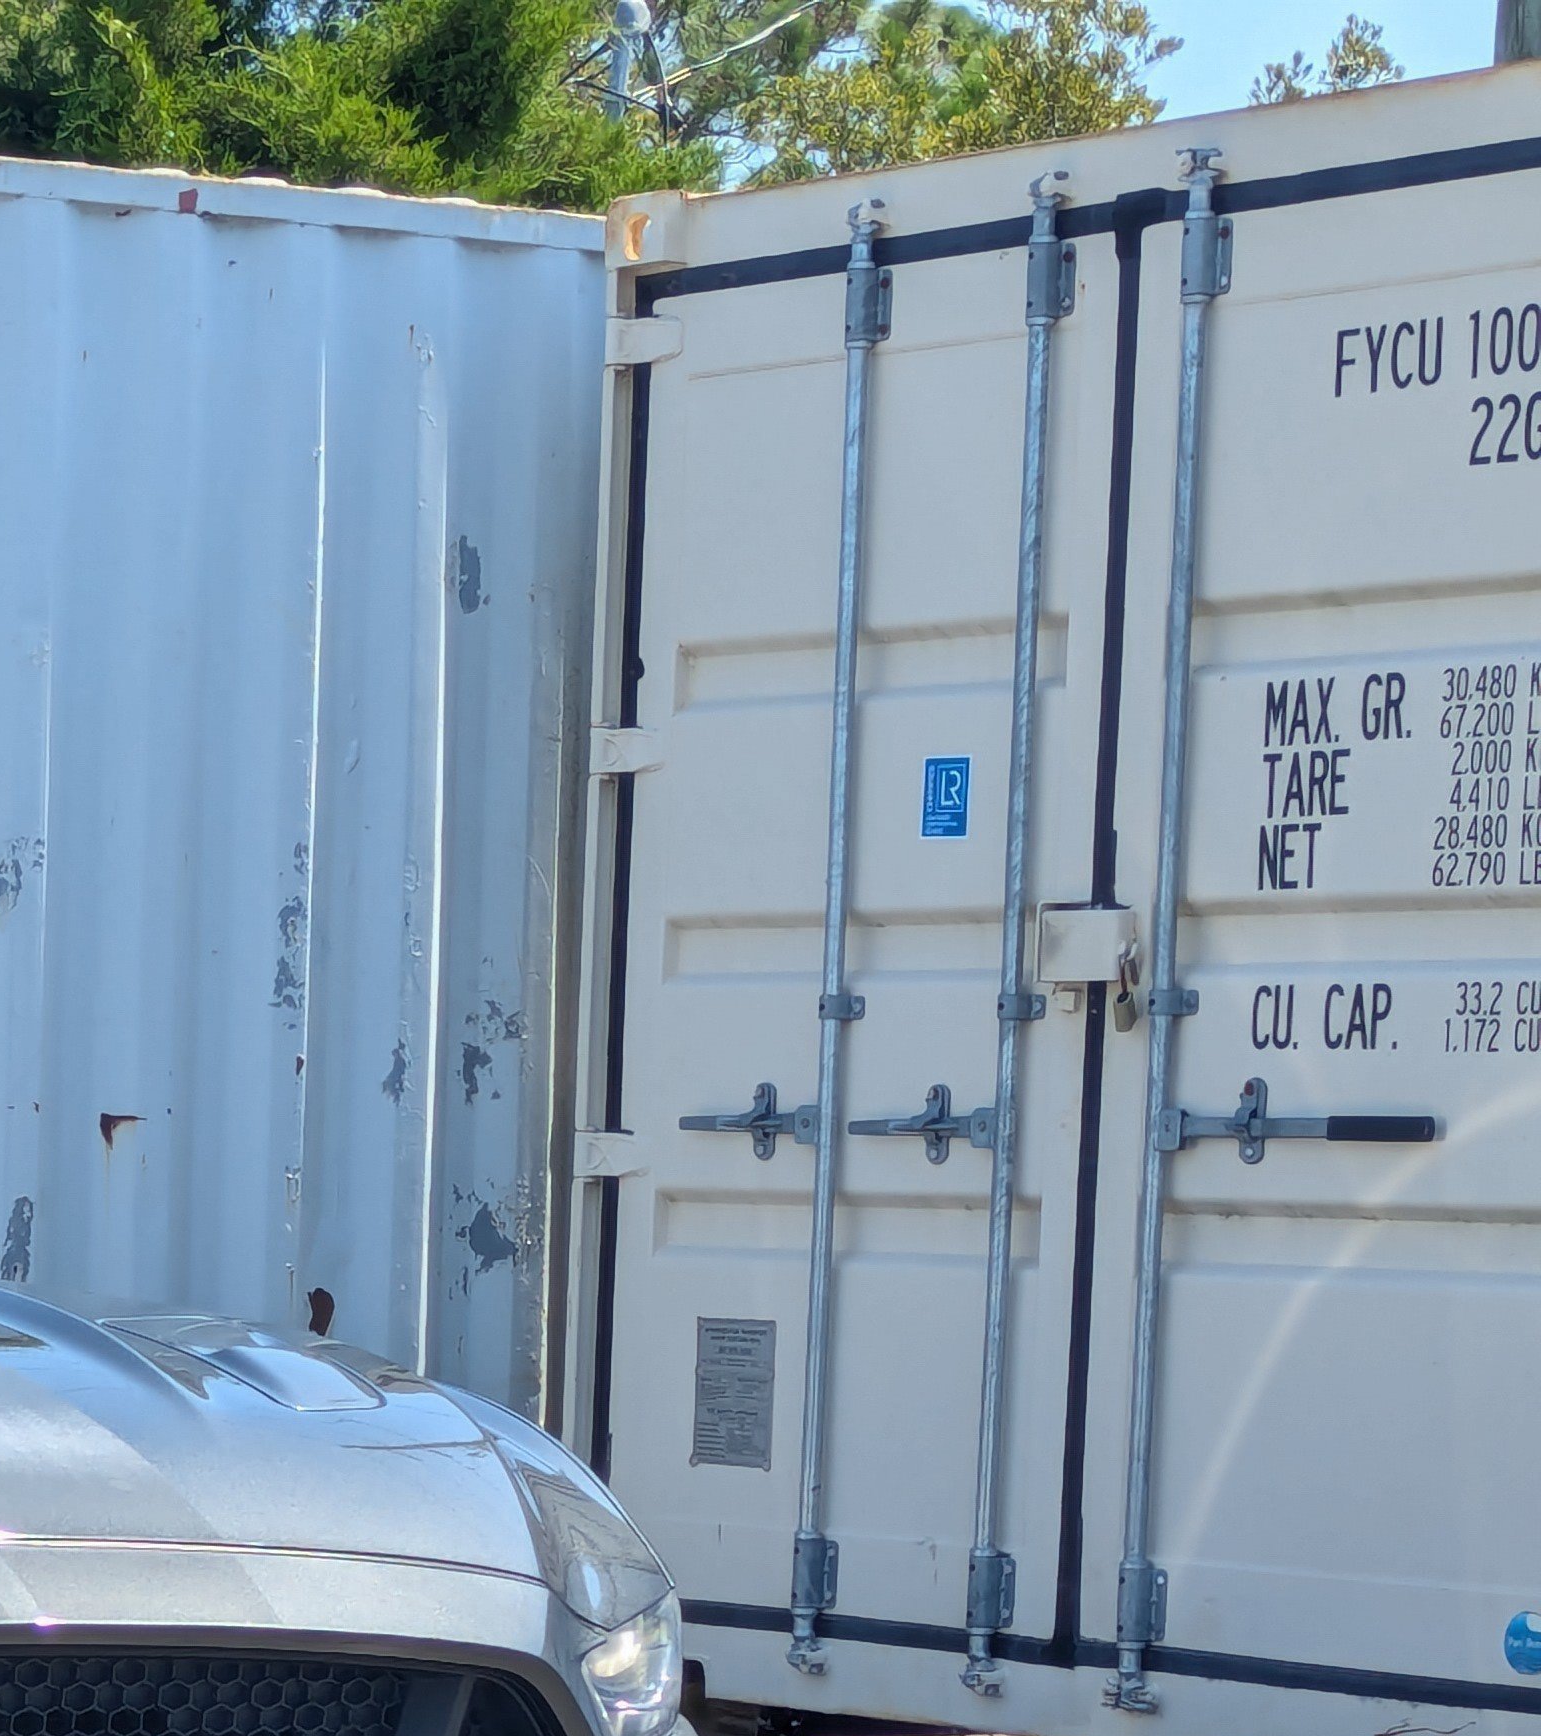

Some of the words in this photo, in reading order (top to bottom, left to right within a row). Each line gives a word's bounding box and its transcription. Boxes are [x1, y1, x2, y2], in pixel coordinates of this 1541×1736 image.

[1334, 316, 1444, 398] FYCU
[1469, 303, 1541, 379] 100
[1468, 391, 1541, 466] 22G
[1441, 664, 1517, 702] 30,480
[1263, 677, 1339, 748] MAX.
[1361, 672, 1412, 741] GR.
[1440, 701, 1515, 739] 67,200
[1262, 748, 1351, 819] TARE
[1449, 776, 1510, 812] 4,410
[1257, 822, 1322, 891] NET
[1433, 813, 1508, 850] 28,480
[1432, 851, 1506, 887] 62,790
[1251, 984, 1299, 1050] CU.
[1323, 982, 1398, 1050] CAP.
[1455, 981, 1503, 1016] 33.2
